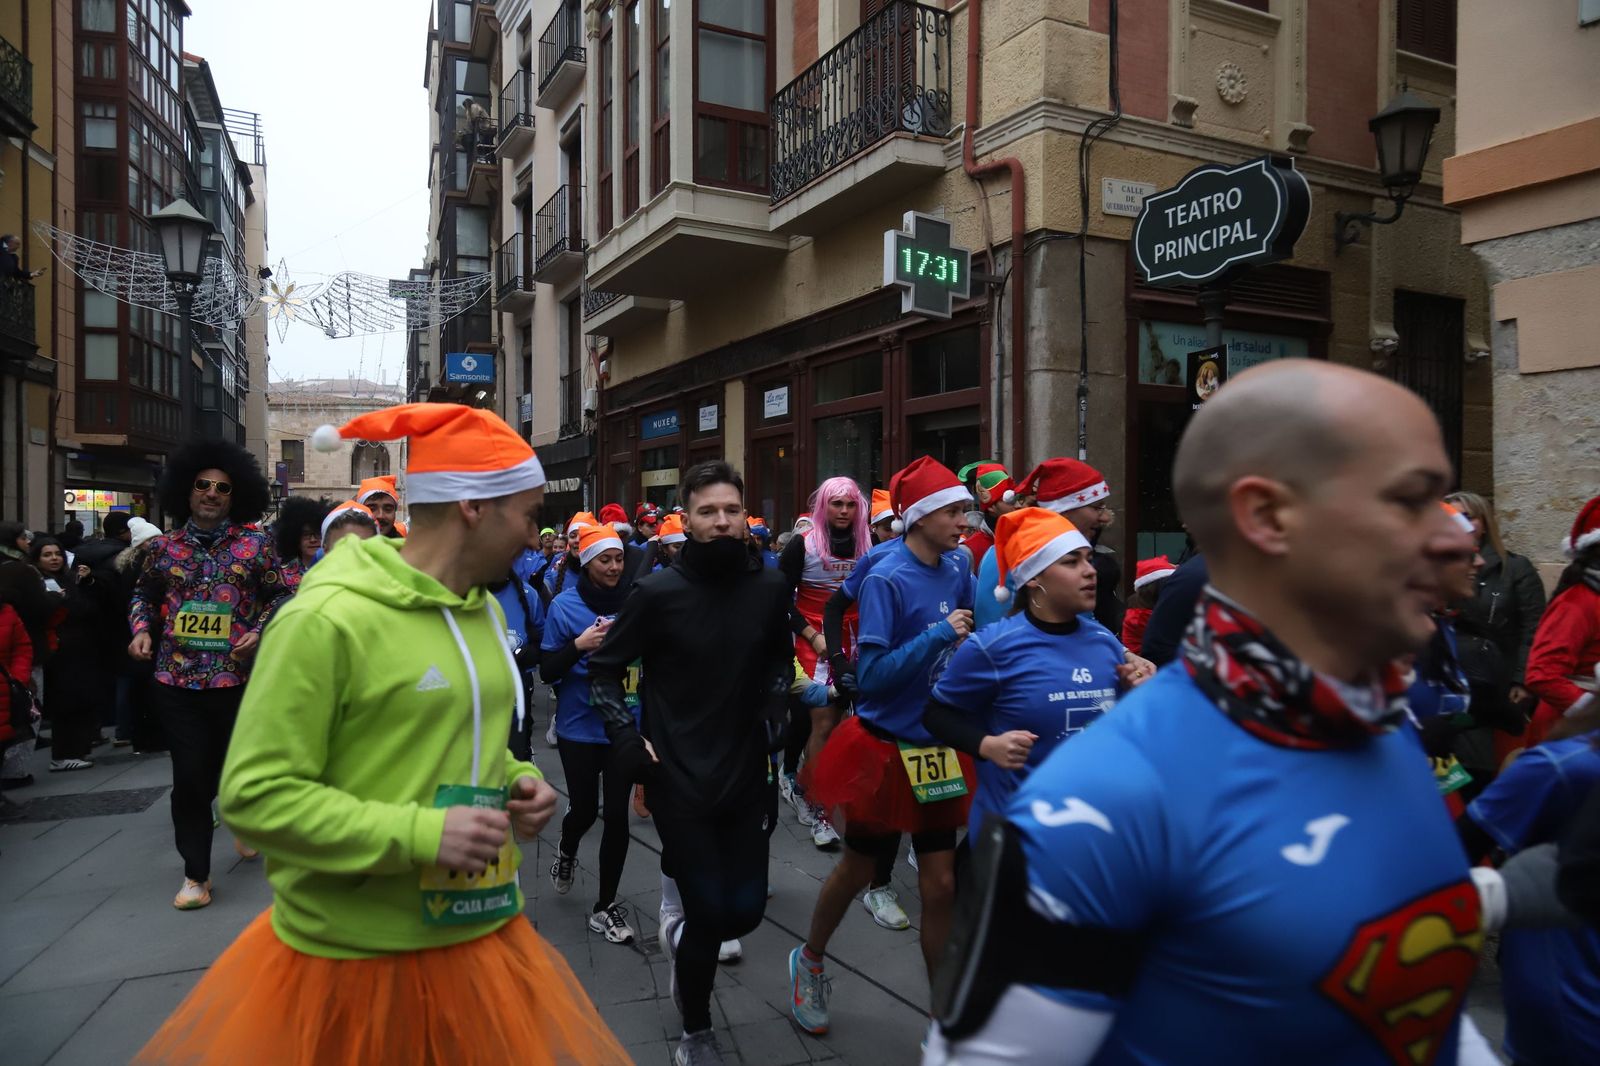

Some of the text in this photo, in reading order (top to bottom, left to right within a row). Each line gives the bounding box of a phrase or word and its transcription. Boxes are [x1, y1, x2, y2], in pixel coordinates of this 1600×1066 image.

[1121, 185, 1144, 195] CALLE
[1125, 195, 1136, 203] DE
[1164, 187, 1242, 229] TEATRO
[1154, 218, 1258, 264] PRINCIPAL
[902, 248, 958, 283] 17:31
[1173, 335, 1186, 346] Un
[1243, 340, 1271, 354] salud
[449, 373, 490, 381] Samsonite
[653, 417, 670, 428] NUXE
[180, 614, 221, 635] 1244
[1071, 668, 1093, 683] 46
[1048, 692, 1065, 702] SAN
[1066, 690, 1102, 699] SILVESTRE
[908, 752, 947, 783] 757
